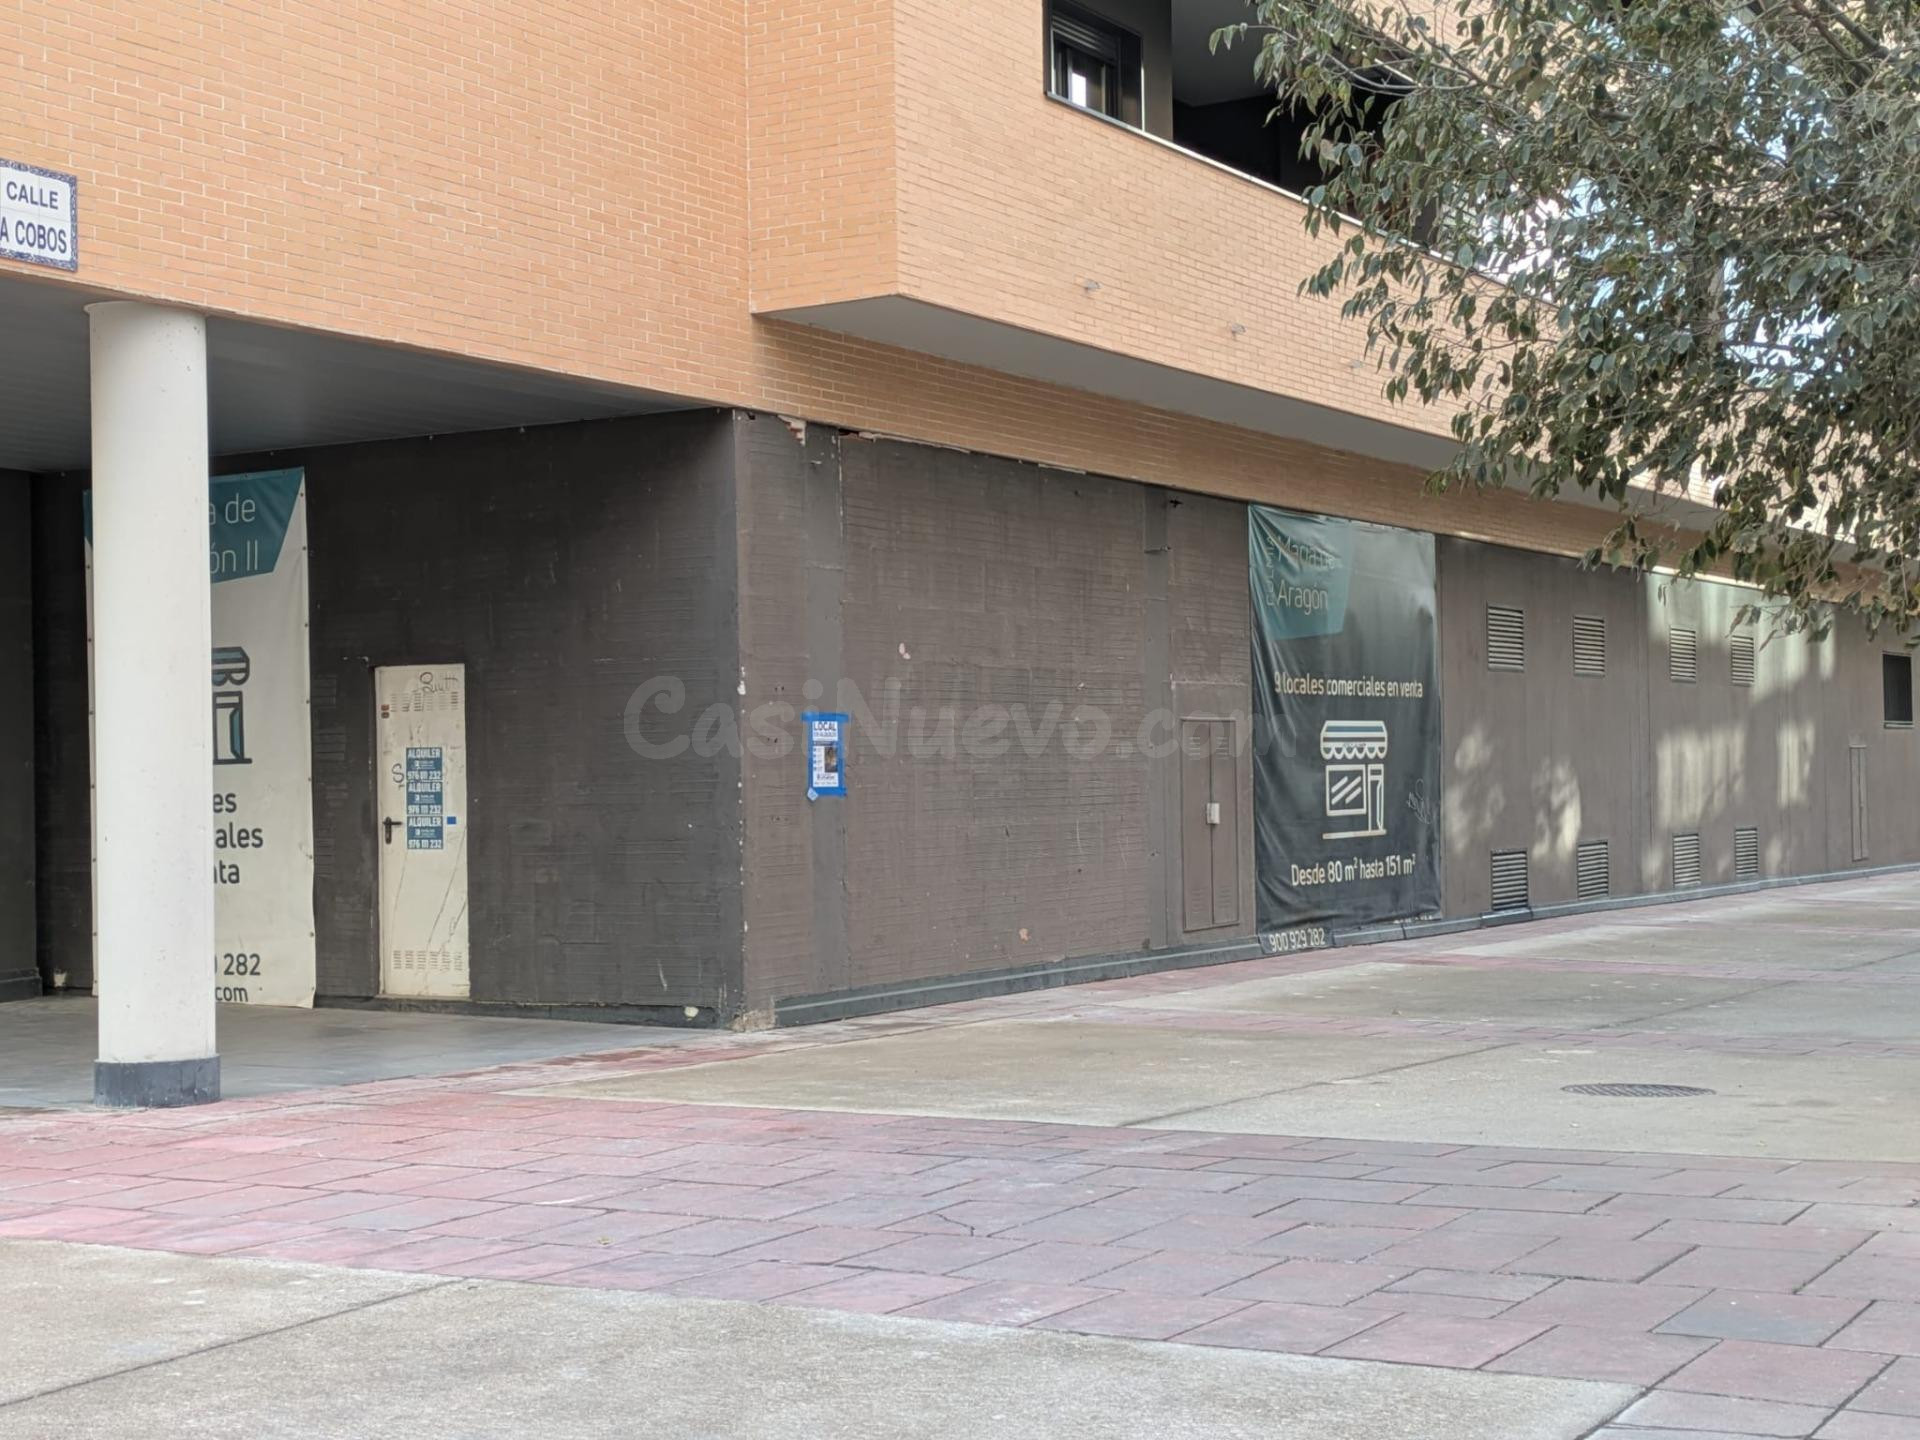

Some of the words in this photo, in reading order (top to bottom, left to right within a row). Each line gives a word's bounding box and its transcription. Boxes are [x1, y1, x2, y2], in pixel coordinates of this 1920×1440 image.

[6, 181, 59, 210] CALLE
[0, 216, 10, 243] A
[15, 219, 68, 254] COBOS
[225, 492, 257, 524] de
[1277, 579, 1328, 616] Aragón
[1282, 673, 1324, 695] locales
[1326, 675, 1386, 698] comerciales
[1387, 681, 1399, 697] en
[1400, 680, 1423, 698] venta
[407, 748, 441, 759] ALQUILER
[408, 782, 441, 793] ALQUILER
[408, 816, 442, 827] ALQUILER
[1291, 864, 1326, 886] Desde
[1328, 860, 1342, 882] 80
[1360, 859, 1384, 880] hasta
[1386, 854, 1401, 876] 151
[1268, 933, 1288, 952] 900
[1290, 930, 1307, 950] 929
[223, 952, 261, 976] 282
